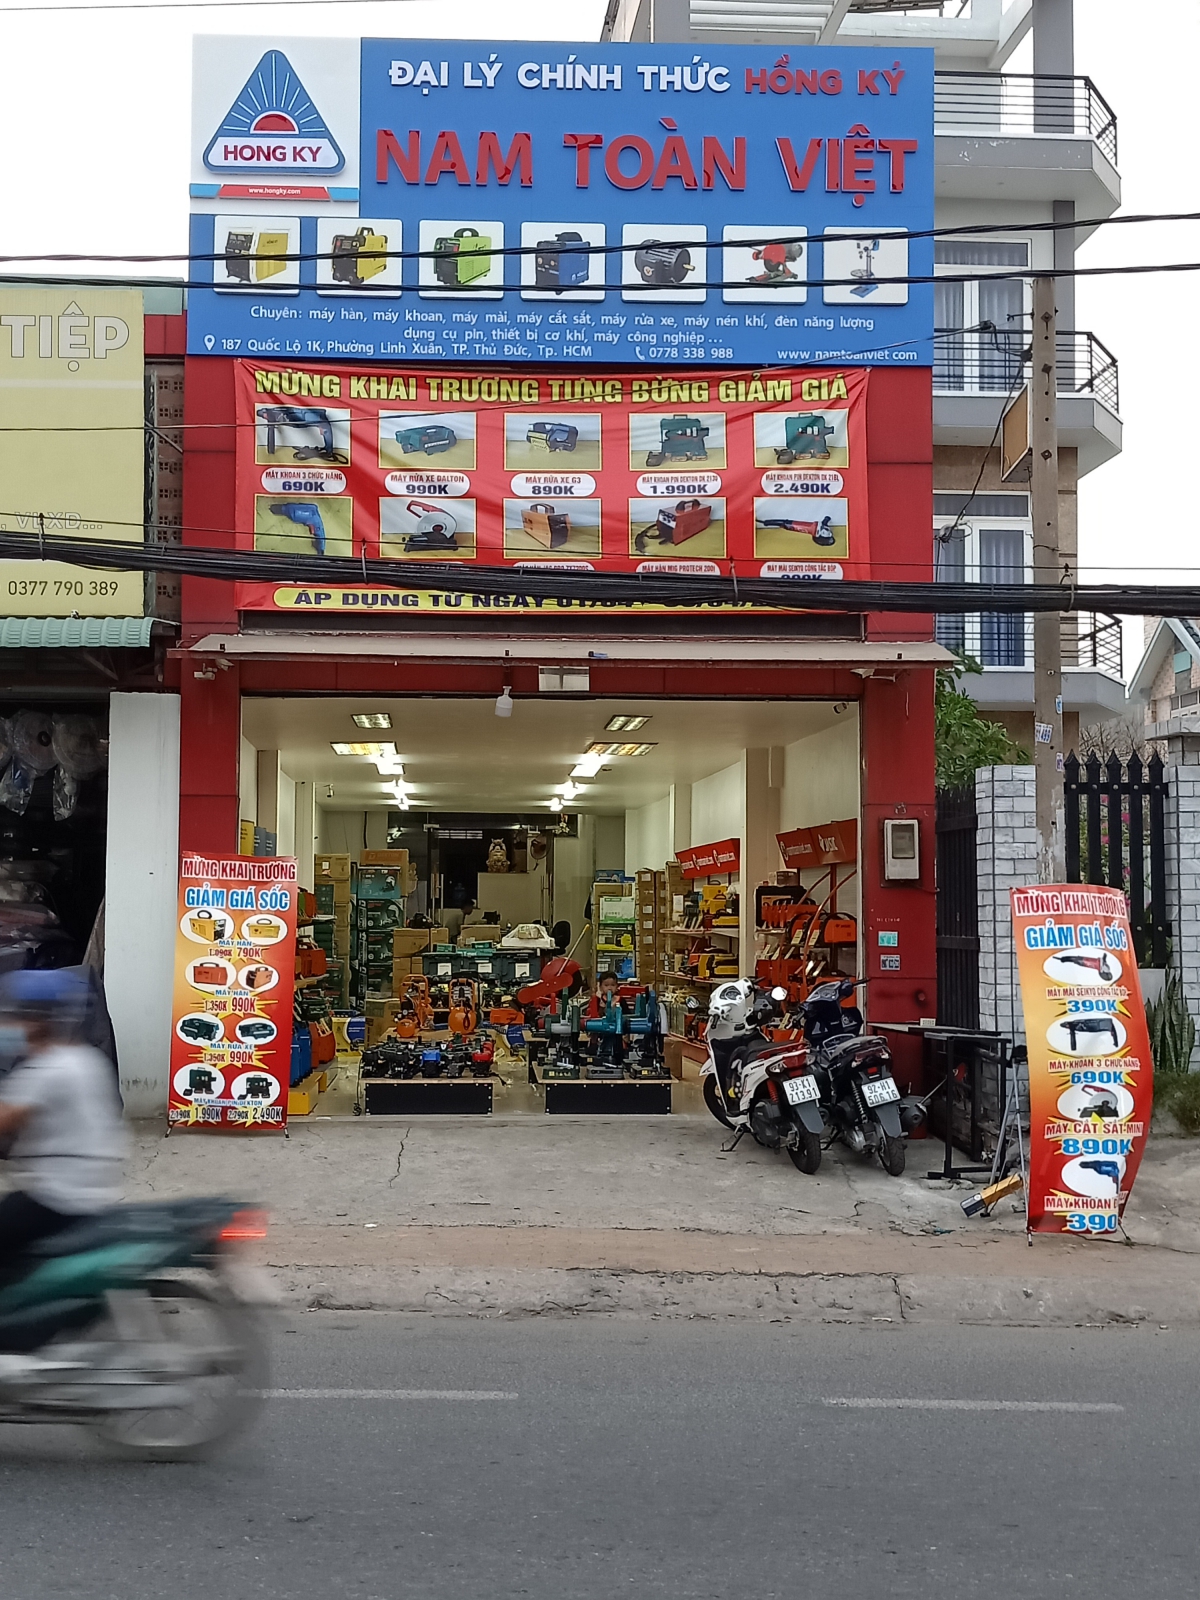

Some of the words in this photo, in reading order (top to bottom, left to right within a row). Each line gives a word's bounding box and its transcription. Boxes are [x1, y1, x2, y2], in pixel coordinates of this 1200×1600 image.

[388, 60, 449, 95] ĐẠI
[463, 53, 502, 88] LÝ
[517, 54, 622, 90] CHÍNH
[637, 55, 730, 91] THỨC
[745, 54, 843, 95] HỒNG
[857, 60, 906, 95] KÝ
[222, 144, 287, 163] HONG
[292, 146, 322, 164] KY
[376, 129, 533, 187] NAM
[563, 117, 747, 191] TOÀN
[775, 123, 918, 207] VIỆT
[248, 187, 301, 197] www.hongky.com
[250, 306, 302, 321] Chuyên:
[309, 308, 335, 323] máy
[341, 307, 367, 323] hàn,
[373, 310, 399, 324] máy
[405, 309, 446, 325] khoan,
[452, 311, 478, 325] máy
[484, 310, 511, 326] mài,
[516, 311, 542, 326] máy
[548, 310, 567, 325] cắt
[573, 310, 596, 327] sắt,
[601, 313, 627, 328] máy
[634, 311, 654, 326] rửa
[660, 315, 678, 329] xe,
[684, 314, 709, 329] máy
[716, 314, 739, 328] nén
[745, 313, 768, 329] khí,
[774, 315, 797, 329] đèn
[804, 316, 834, 331] năng
[840, 316, 874, 331] lượng
[0, 301, 130, 372] TIỆP
[403, 326, 435, 341] dụng
[442, 328, 457, 341] cụ
[464, 328, 488, 343] pin,
[491, 327, 520, 341] thiết
[526, 327, 538, 342] bị
[545, 331, 560, 342] cơ
[565, 330, 588, 344] khí,
[594, 331, 620, 346] máy
[627, 331, 656, 346] công
[663, 331, 704, 347] nghiệp
[221, 339, 241, 351] 187
[247, 337, 280, 353] Quốc
[286, 339, 301, 354] Lộ
[306, 341, 325, 355] 1K,
[327, 339, 374, 357] Phường
[380, 341, 406, 355] Linh
[412, 341, 447, 357] Xuân,
[451, 343, 470, 356] TP.
[474, 340, 497, 356] Thủ
[503, 342, 532, 358] Đức,
[537, 345, 558, 358] Tp.
[563, 345, 592, 357] HCM
[649, 347, 678, 359] 0778
[683, 348, 705, 359] 338
[711, 348, 733, 360] 988
[255, 369, 340, 398] MỪNG
[350, 376, 417, 401] KHAI
[631, 375, 709, 403] BỪNG
[719, 373, 792, 402] GIẢM
[802, 374, 848, 401] GIÁ
[282, 480, 325, 492] 690K
[406, 484, 449, 495] 990K
[531, 485, 575, 495] 890K
[650, 484, 708, 495] 1.990K
[774, 483, 831, 494] 2.490K
[8, 581, 51, 596] 0377
[54, 581, 83, 596] 790
[88, 581, 118, 596] 389
[293, 589, 332, 605] ÁP
[341, 592, 419, 610] DỤNG
[183, 857, 218, 877] MỪNG
[221, 862, 248, 879] KHAI
[186, 882, 225, 907] GIẢM
[230, 886, 254, 909] GIÁ
[259, 885, 289, 910] SỐC
[1016, 891, 1060, 915] MỪNG
[1063, 894, 1090, 914] KHAI
[1026, 919, 1074, 948] GIẢM
[1079, 922, 1104, 948] GIÁ
[1105, 922, 1127, 949] SỐC
[236, 947, 261, 958] 790K
[231, 997, 256, 1012] 990K
[1067, 999, 1118, 1013] 390K
[229, 1051, 254, 1063] 990K
[1069, 1058, 1094, 1068] KHOAN
[1096, 1058, 1102, 1067] 3
[1071, 1070, 1125, 1084] 690K
[195, 1107, 221, 1120] 1.990K
[252, 1107, 281, 1121] 2.490K
[1062, 1138, 1131, 1155] 890K
[1073, 1197, 1111, 1210] KHOAN
